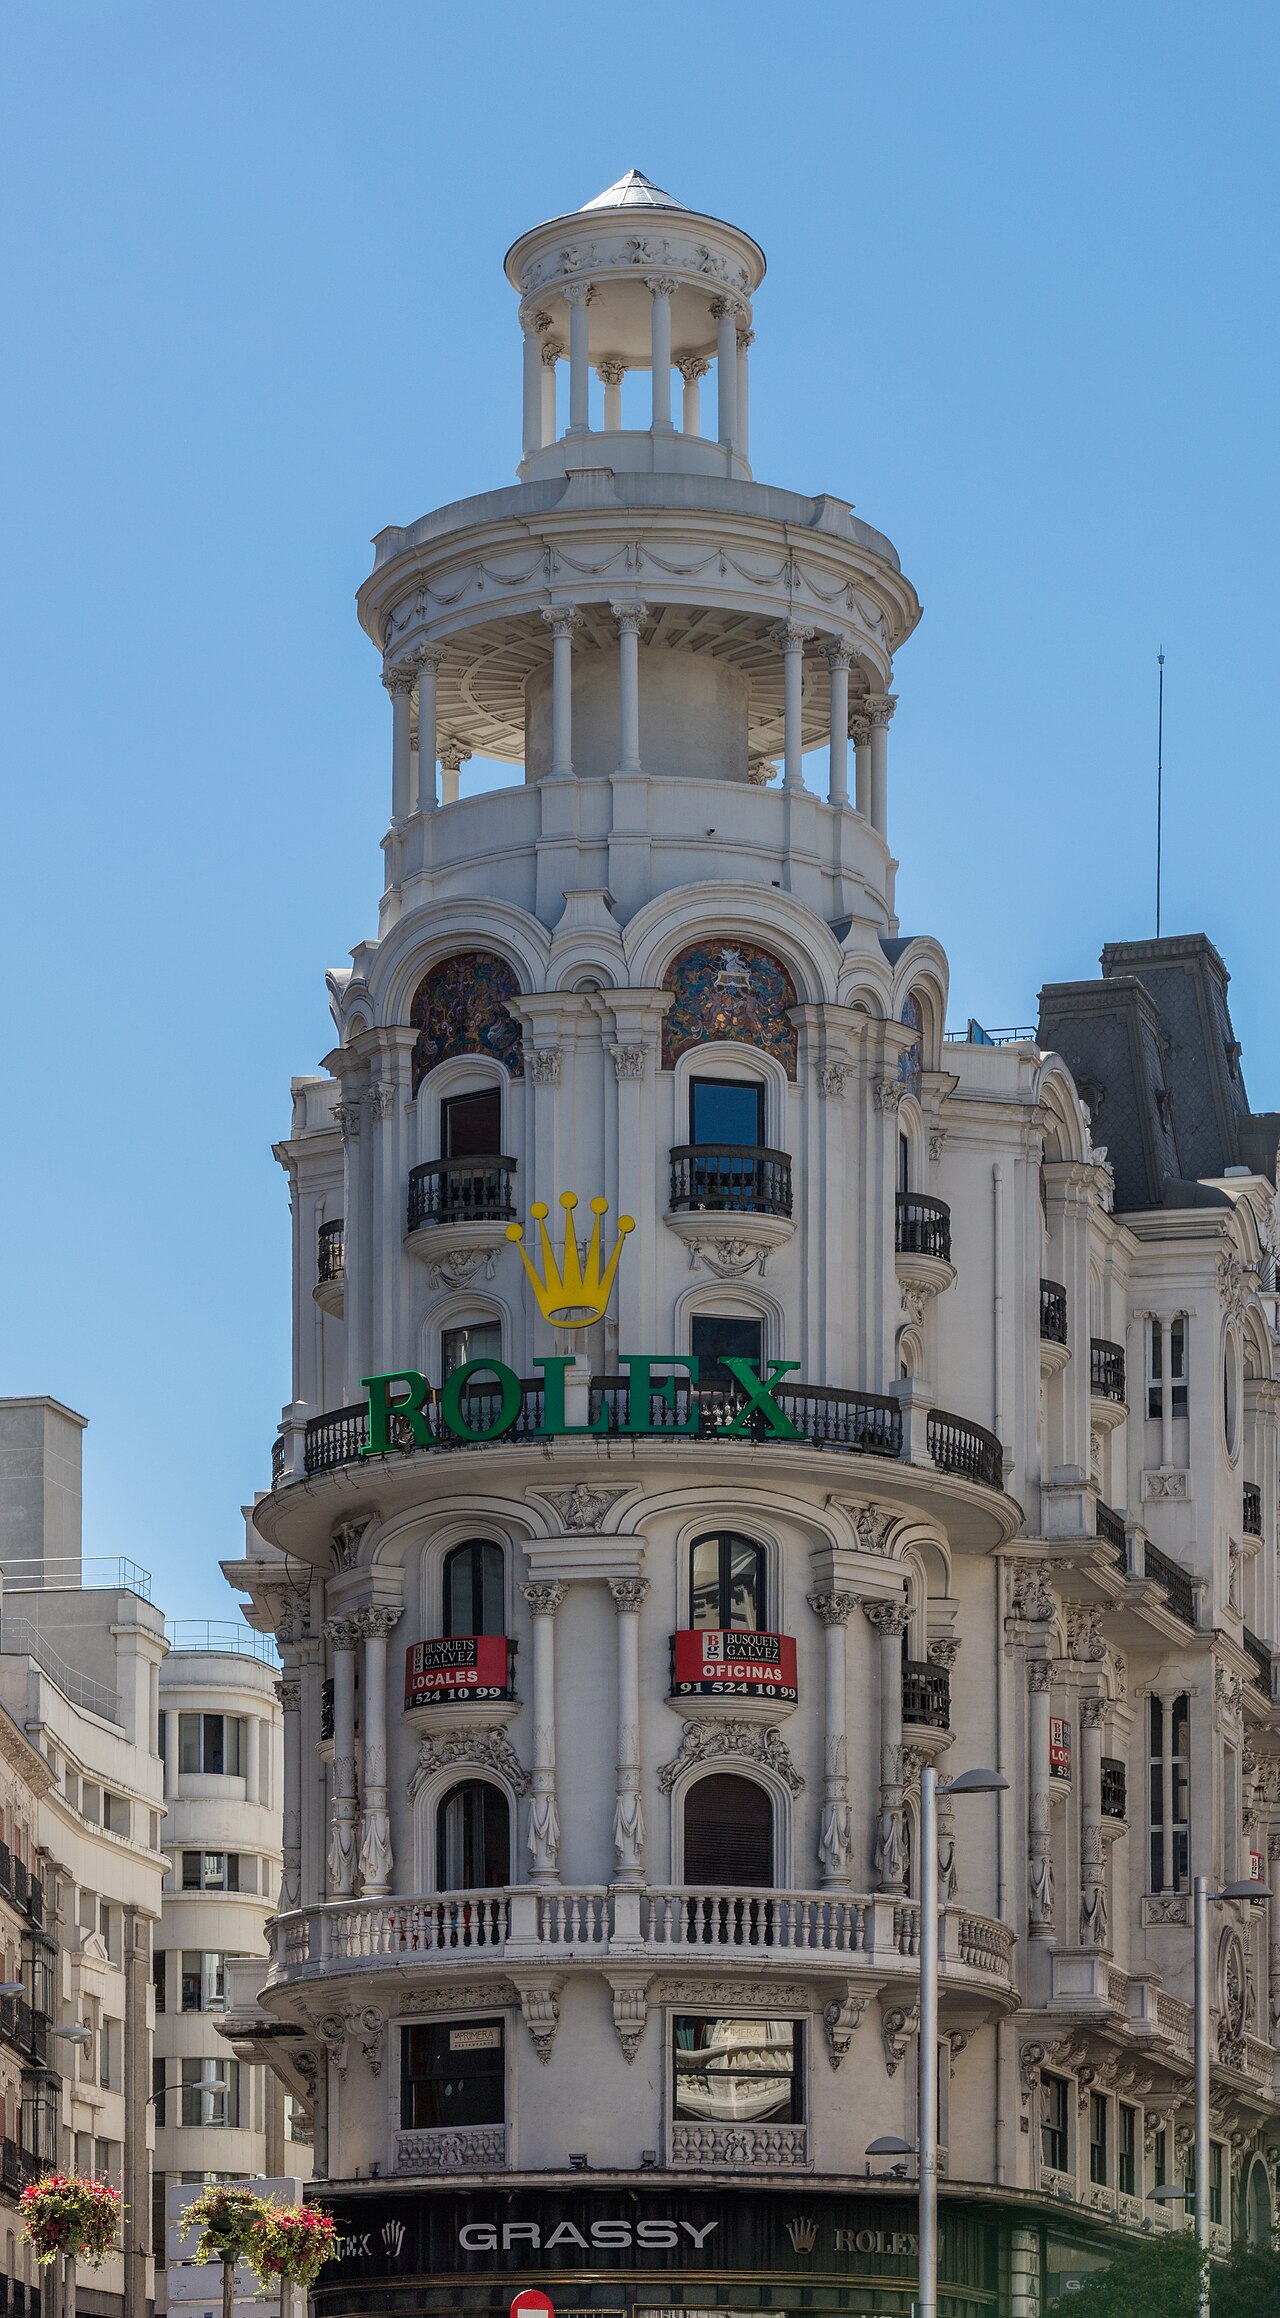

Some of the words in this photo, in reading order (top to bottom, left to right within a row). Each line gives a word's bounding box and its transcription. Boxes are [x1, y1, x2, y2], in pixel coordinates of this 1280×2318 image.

[360, 1354, 808, 1455] ROLEX
[425, 1639, 475, 1654] BUSQUETS
[727, 1634, 779, 1648] BUSQUETS
[425, 1651, 474, 1665] GALVEZ
[726, 1645, 779, 1659] GALVEZ
[412, 1670, 478, 1690] LOCALES
[702, 1665, 782, 1681] OFICINAS
[415, 1690, 441, 1704] 524
[447, 1688, 470, 1700] 10
[476, 1687, 501, 1699] 99
[680, 1682, 703, 1693] 91
[711, 1682, 749, 1693] 524
[755, 1684, 776, 1695] 10
[780, 1686, 796, 1699] 99
[459, 2220, 719, 2250] GRASSY
[833, 2228, 919, 2256] ROLEX
[335, 2233, 373, 2258] LEX
